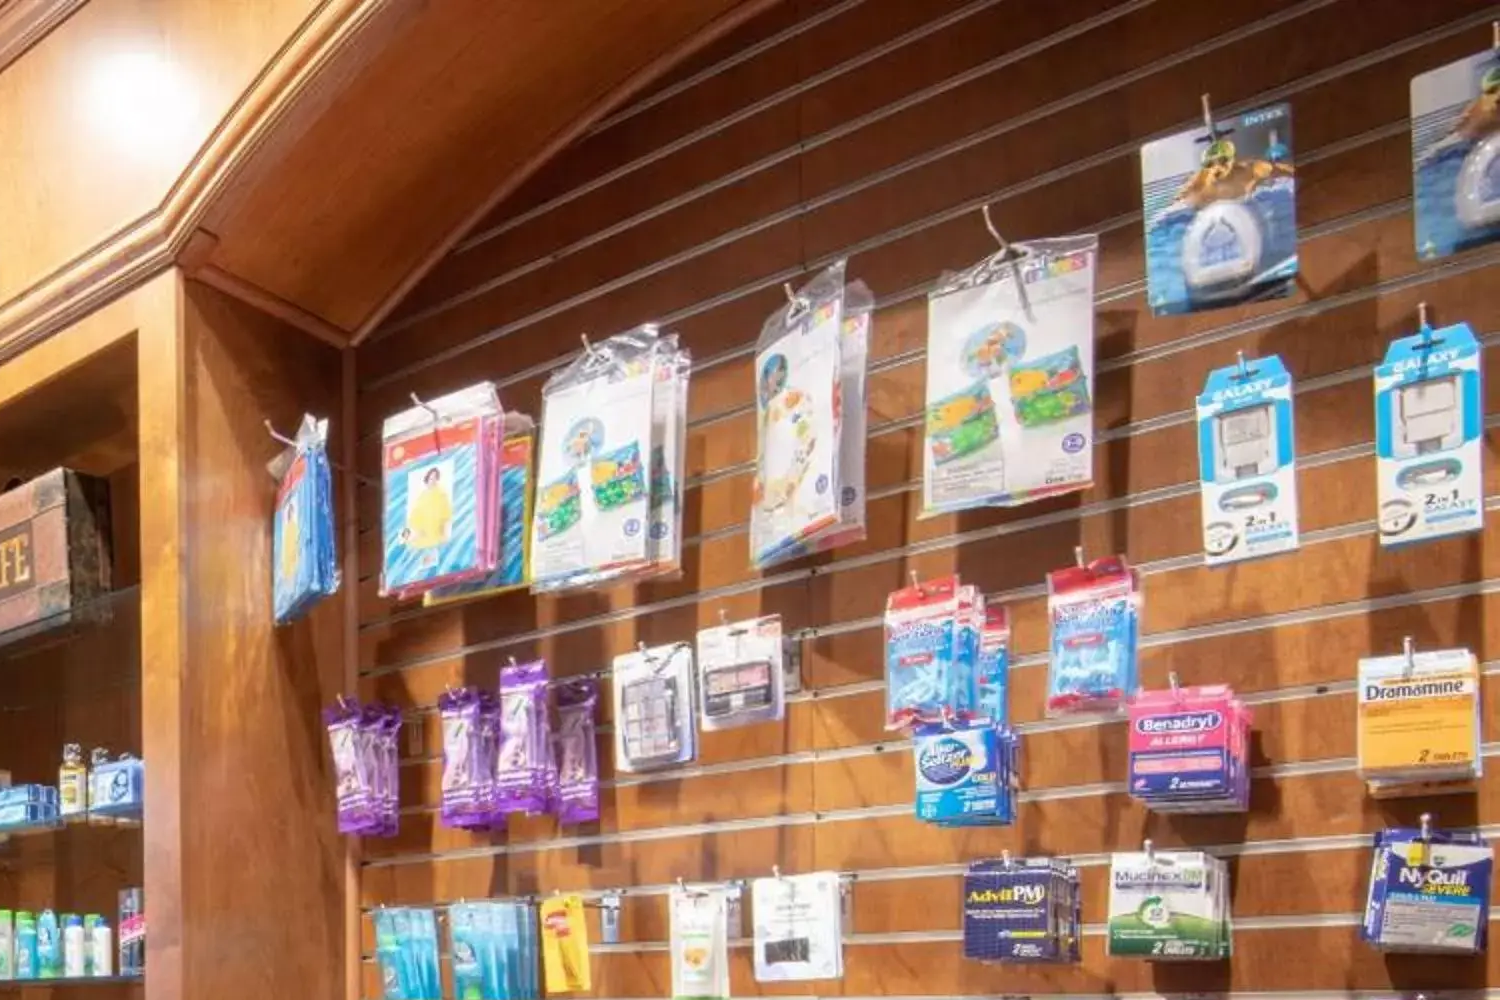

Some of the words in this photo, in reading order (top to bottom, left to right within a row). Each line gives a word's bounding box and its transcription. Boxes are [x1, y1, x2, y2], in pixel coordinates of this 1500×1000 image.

[1244, 109, 1284, 127] INTEX
[1366, 681, 1465, 700] Dramamine
[1143, 714, 1213, 731] Benadryl
[1150, 734, 1206, 747] ALLERGY
[1399, 867, 1468, 888] NyQuil
[1423, 884, 1471, 897] SEVERE
